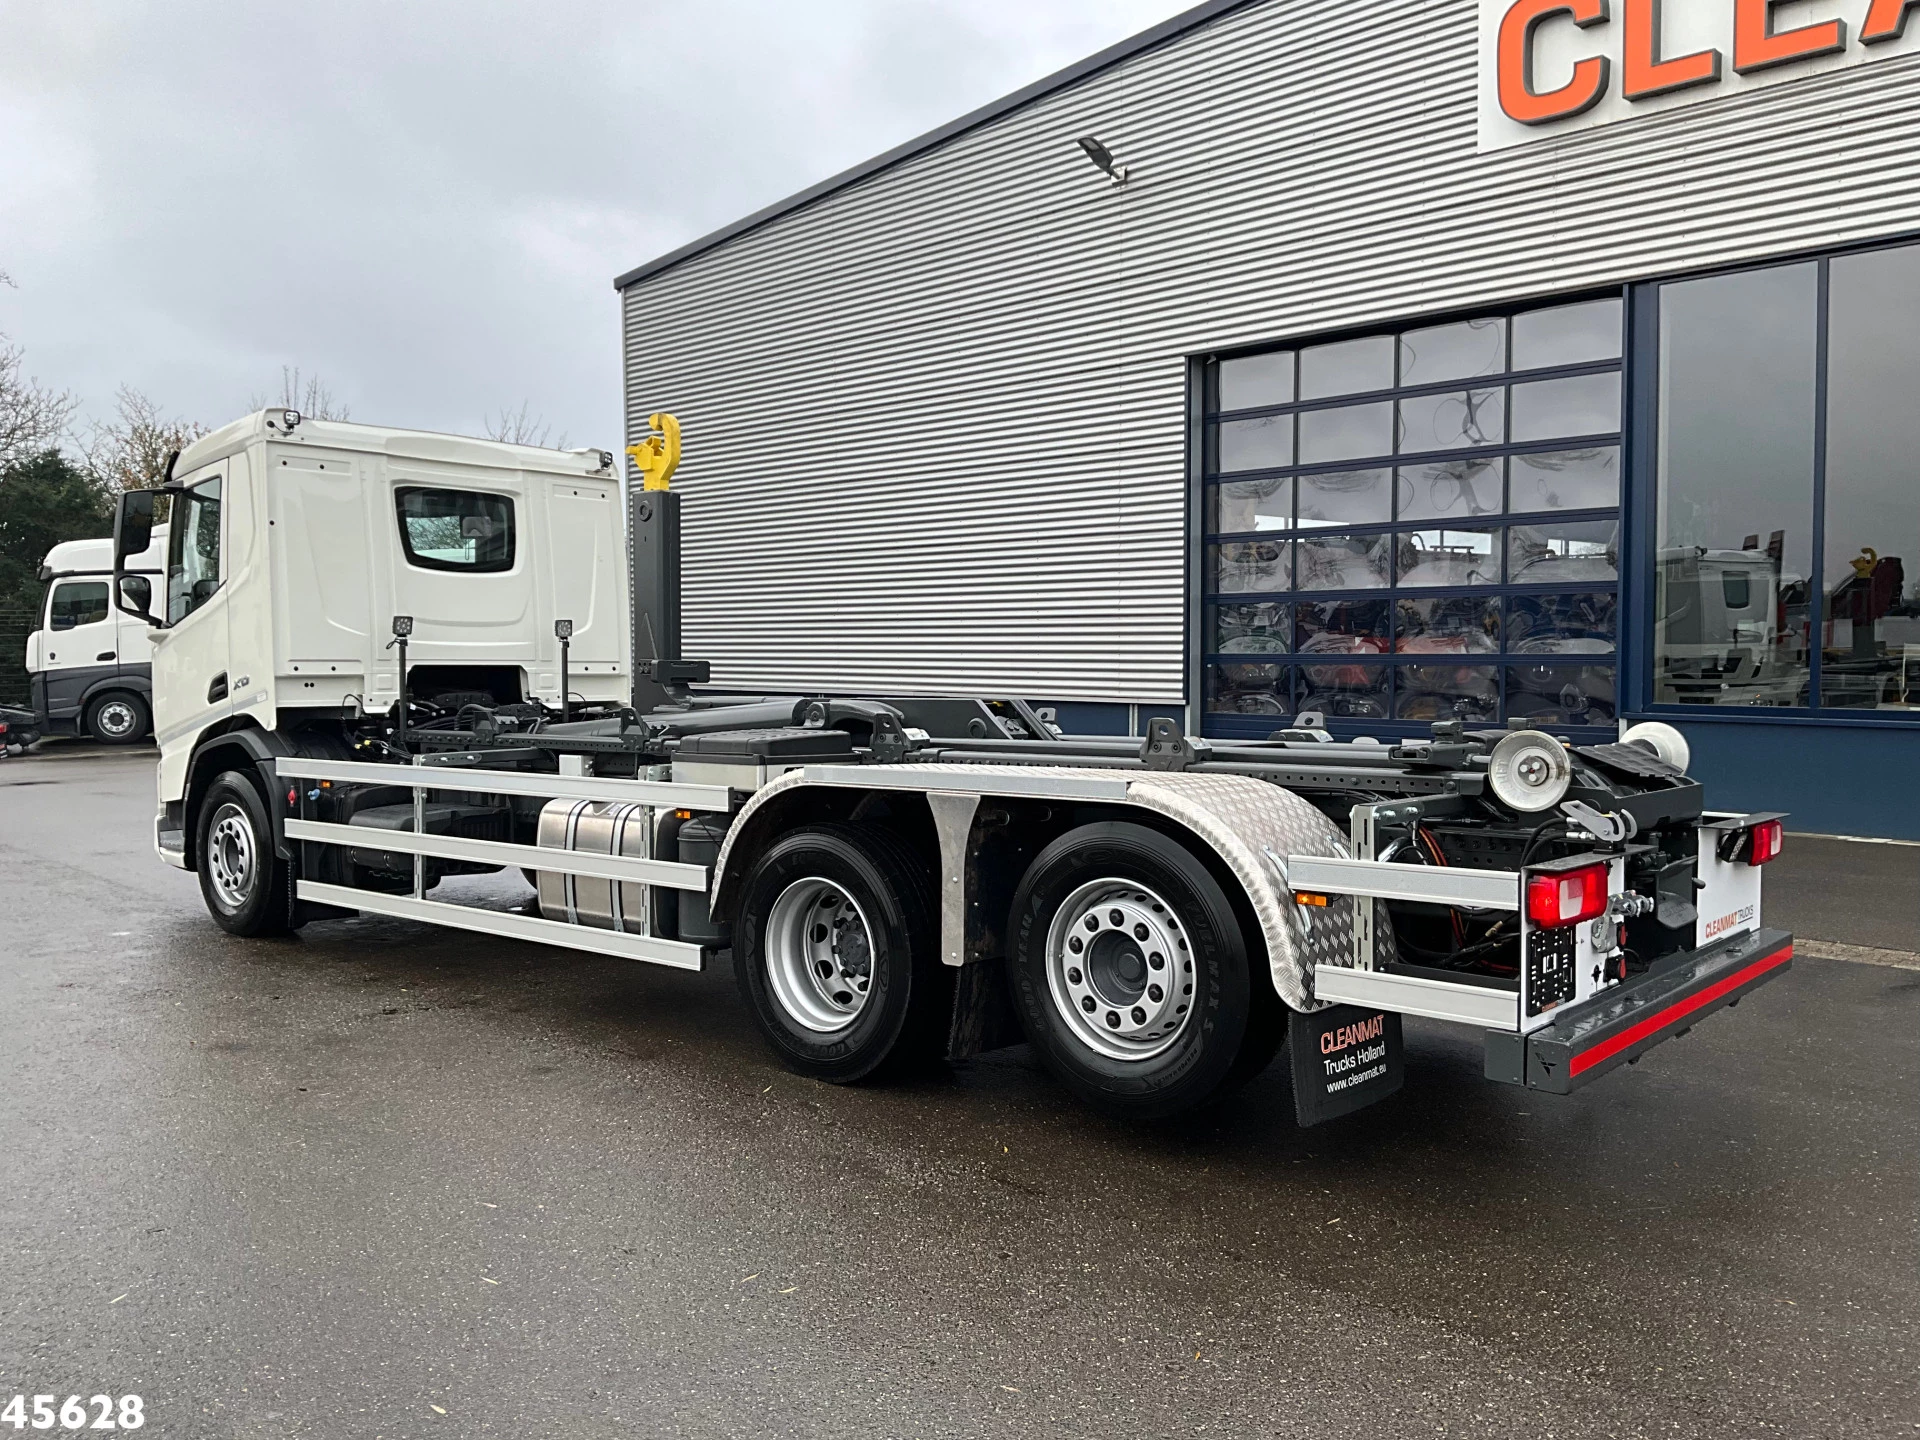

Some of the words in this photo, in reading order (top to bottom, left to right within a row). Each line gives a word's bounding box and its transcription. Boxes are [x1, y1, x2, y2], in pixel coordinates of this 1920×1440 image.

[1497, 0, 1920, 126] CL
[233, 676, 250, 691] XD
[1705, 911, 1738, 939] CLEANMAT
[1320, 1014, 1384, 1054] CLEANMAT
[1323, 1054, 1356, 1076] Trucks
[1356, 1040, 1386, 1065] Holland
[1326, 1063, 1387, 1094] www.cleanmat.eu
